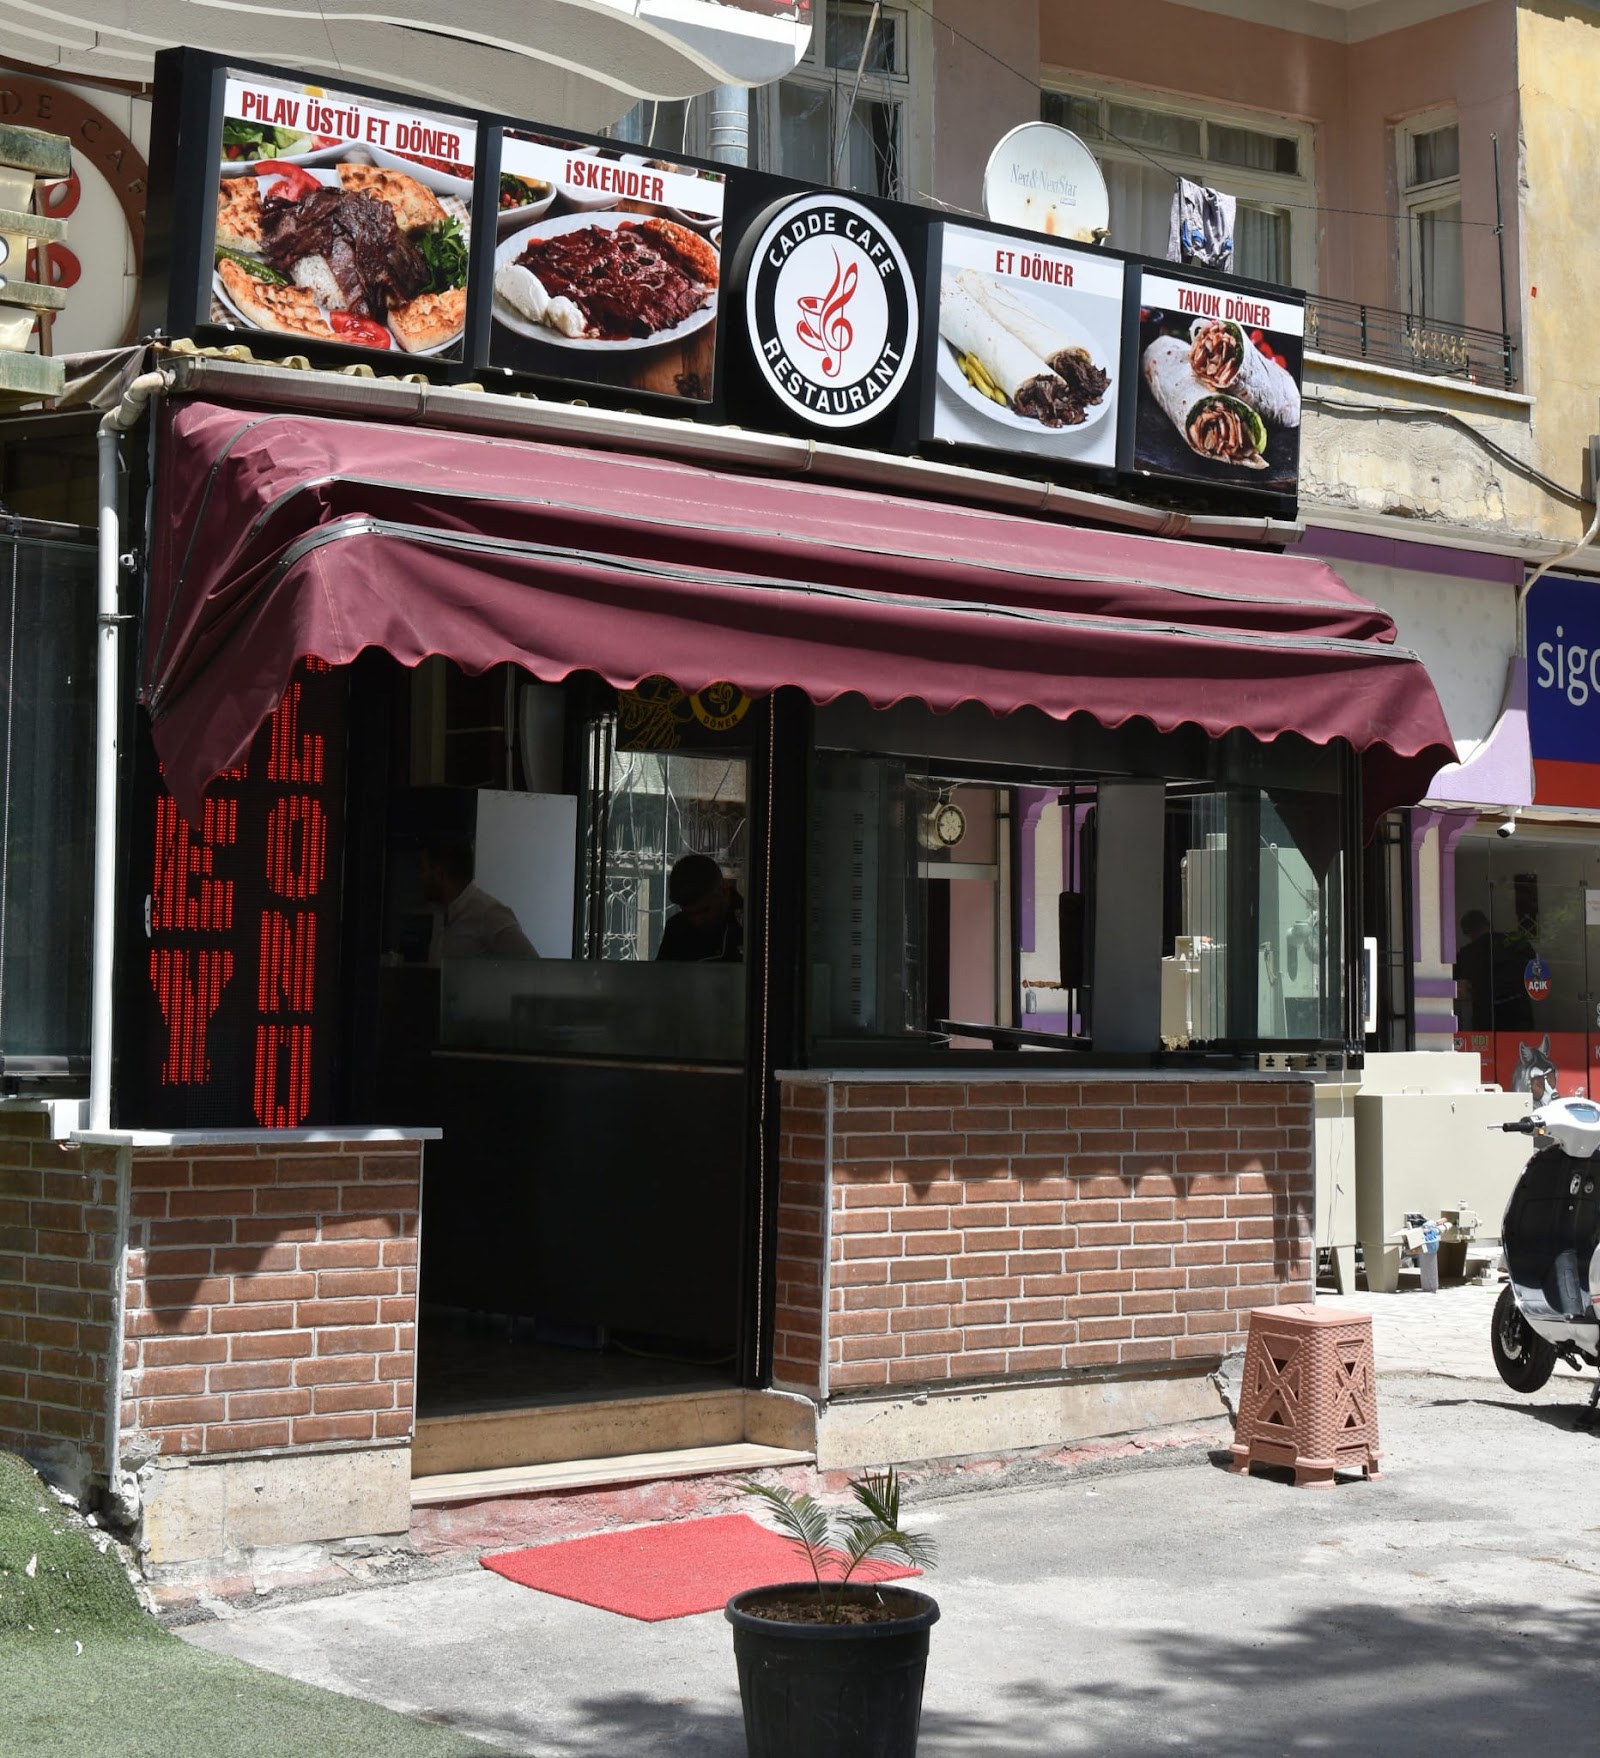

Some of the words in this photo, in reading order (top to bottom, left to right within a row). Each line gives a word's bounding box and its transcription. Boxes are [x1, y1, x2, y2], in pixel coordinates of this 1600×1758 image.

[305, 98, 361, 138] ÜSTÜ
[366, 117, 389, 143] ET
[396, 120, 461, 160] DÖNER
[81, 118, 146, 222] CAF
[769, 212, 836, 268] CADDE
[845, 218, 896, 278] CAFE
[996, 250, 1015, 273] ET
[1020, 254, 1074, 287] DÖNER
[1178, 289, 1220, 318] TAVUK
[1226, 296, 1271, 327] DÖNER
[763, 337, 901, 413] RESTAURANT
[1528, 981, 1548, 992] AÇIK
